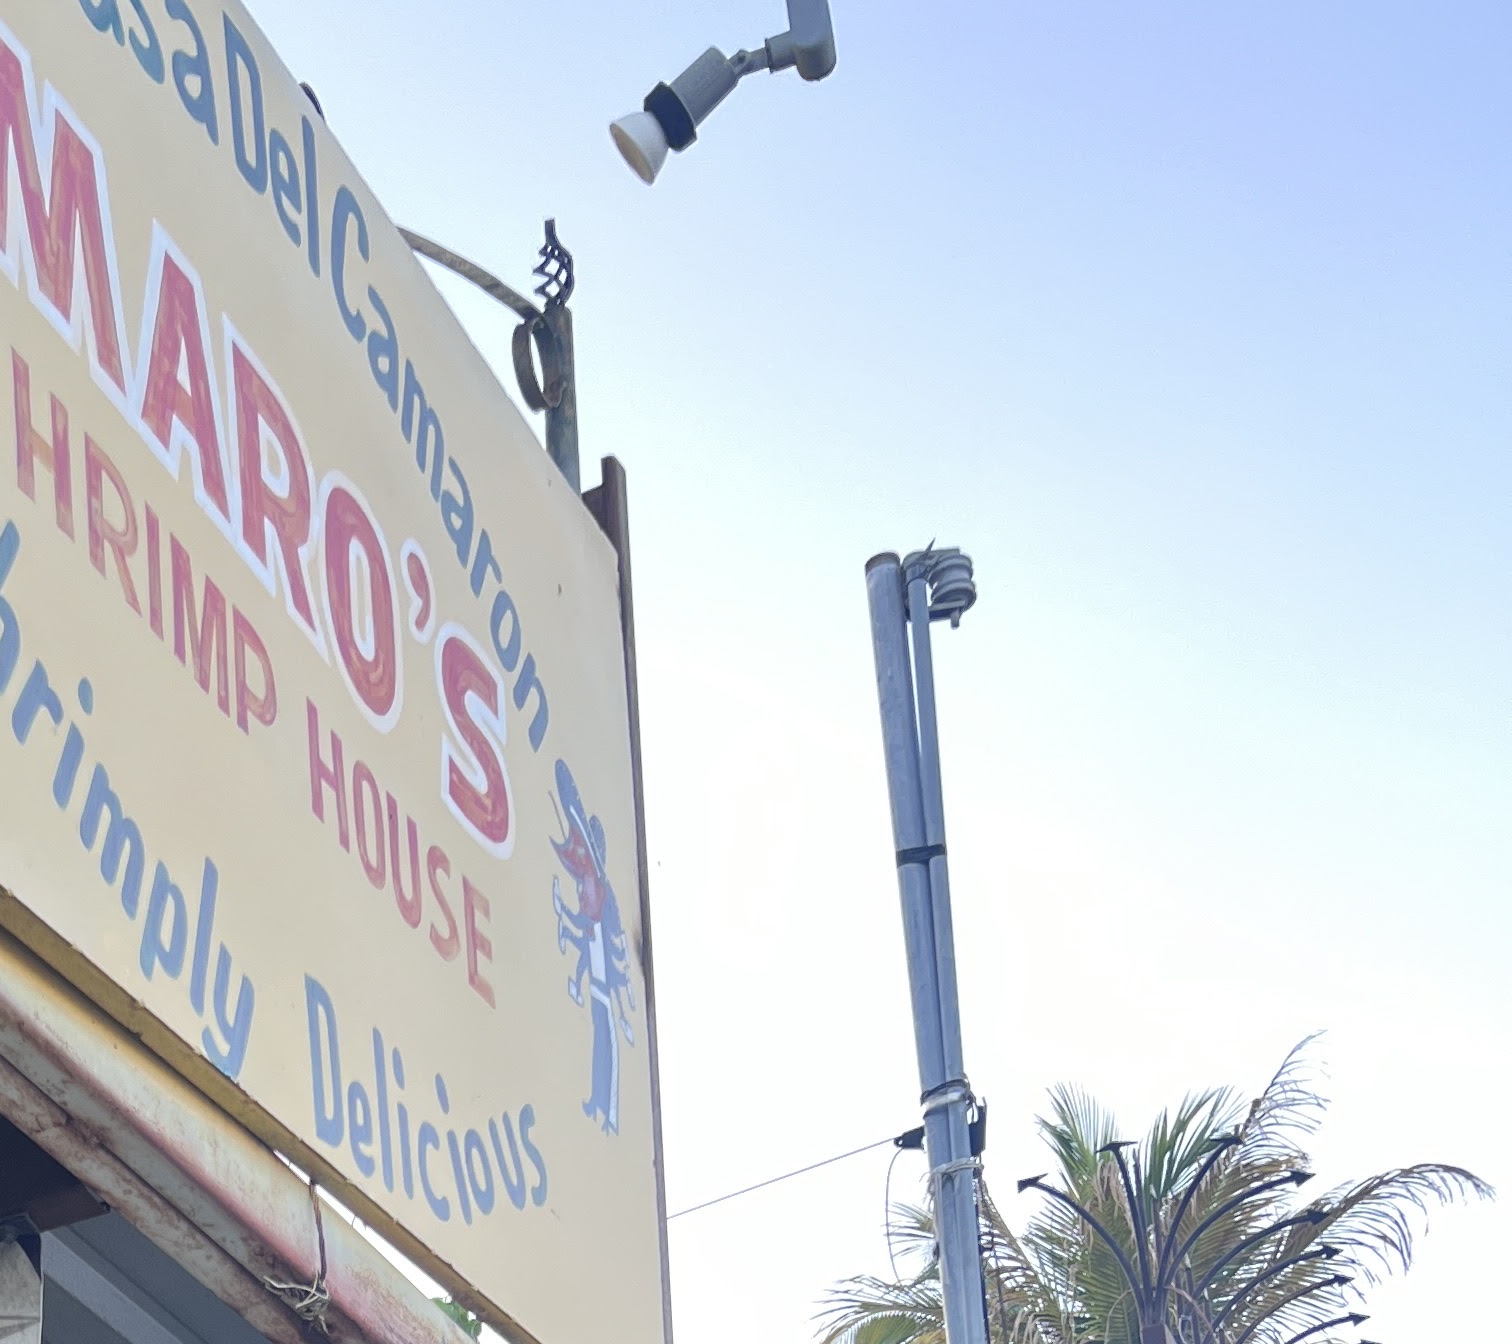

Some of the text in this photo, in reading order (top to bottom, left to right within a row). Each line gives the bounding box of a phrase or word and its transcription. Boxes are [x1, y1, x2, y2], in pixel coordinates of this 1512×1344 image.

[330, 184, 549, 753] Camaron
[306, 696, 496, 1010] HOUSE
[303, 972, 548, 1226] Delicious
